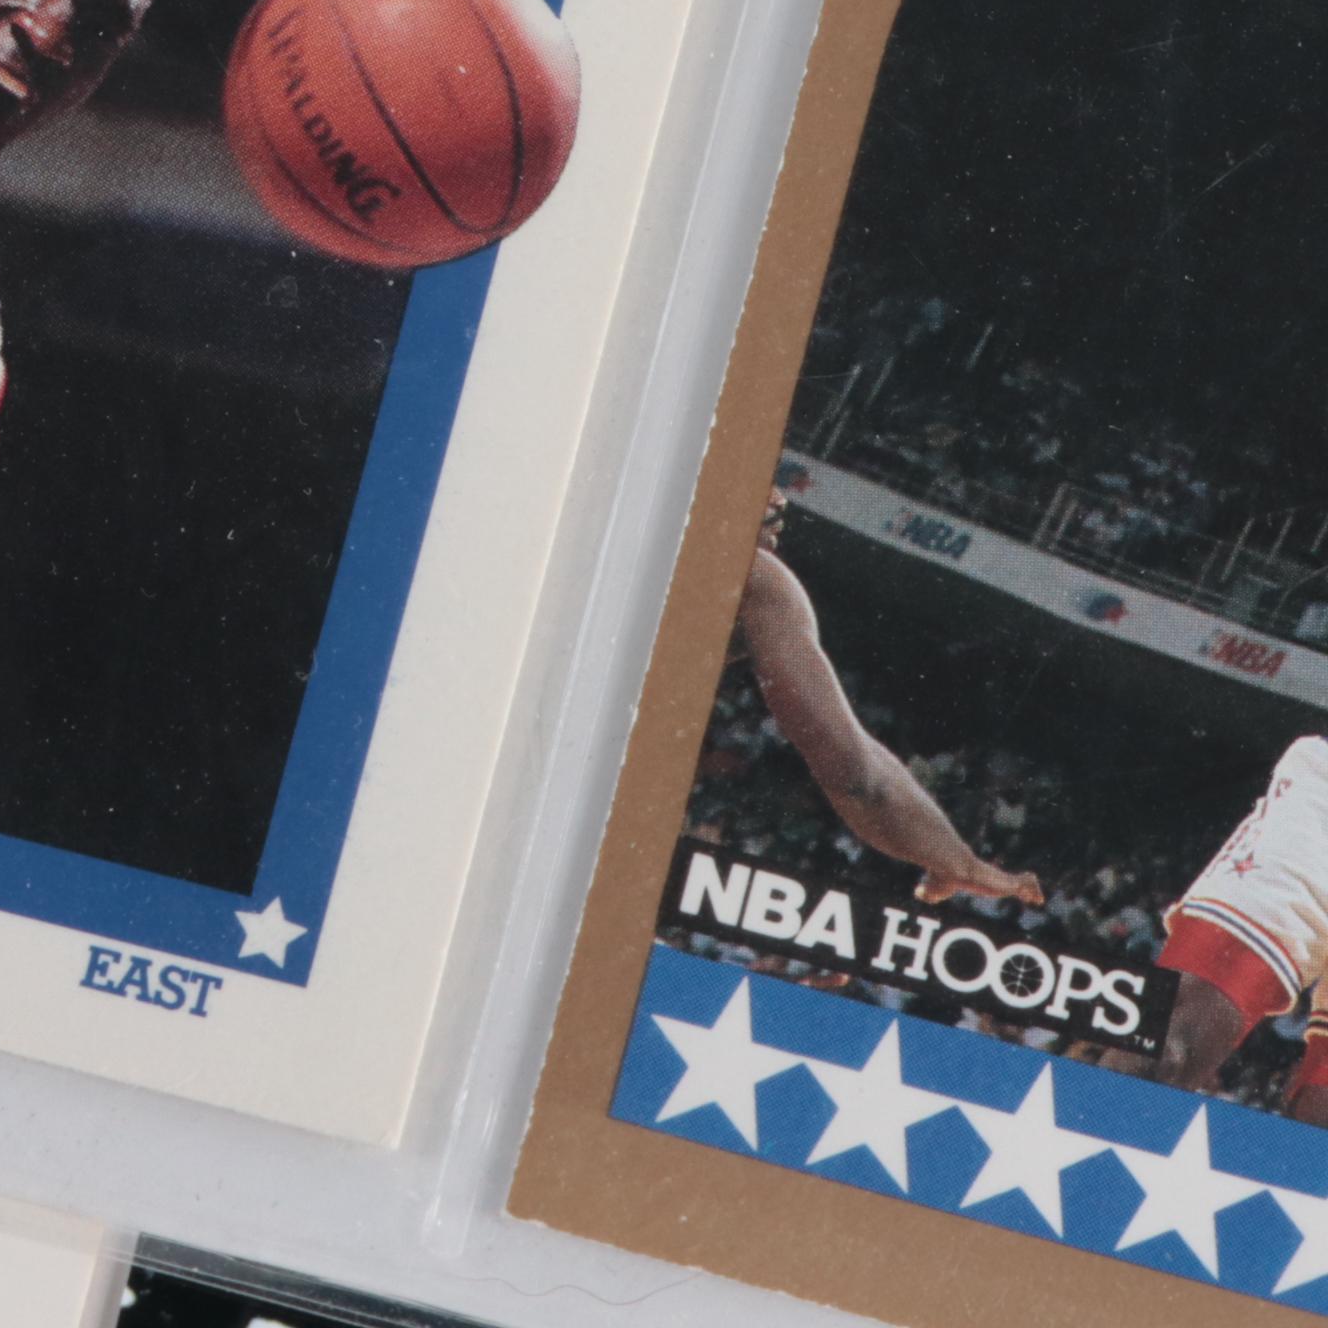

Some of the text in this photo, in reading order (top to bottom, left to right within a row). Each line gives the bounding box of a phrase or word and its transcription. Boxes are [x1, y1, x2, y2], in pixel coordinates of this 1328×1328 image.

[79, 944, 224, 1018] EAST
[679, 851, 857, 959] NBA
[870, 904, 1146, 1037] HOOPS
